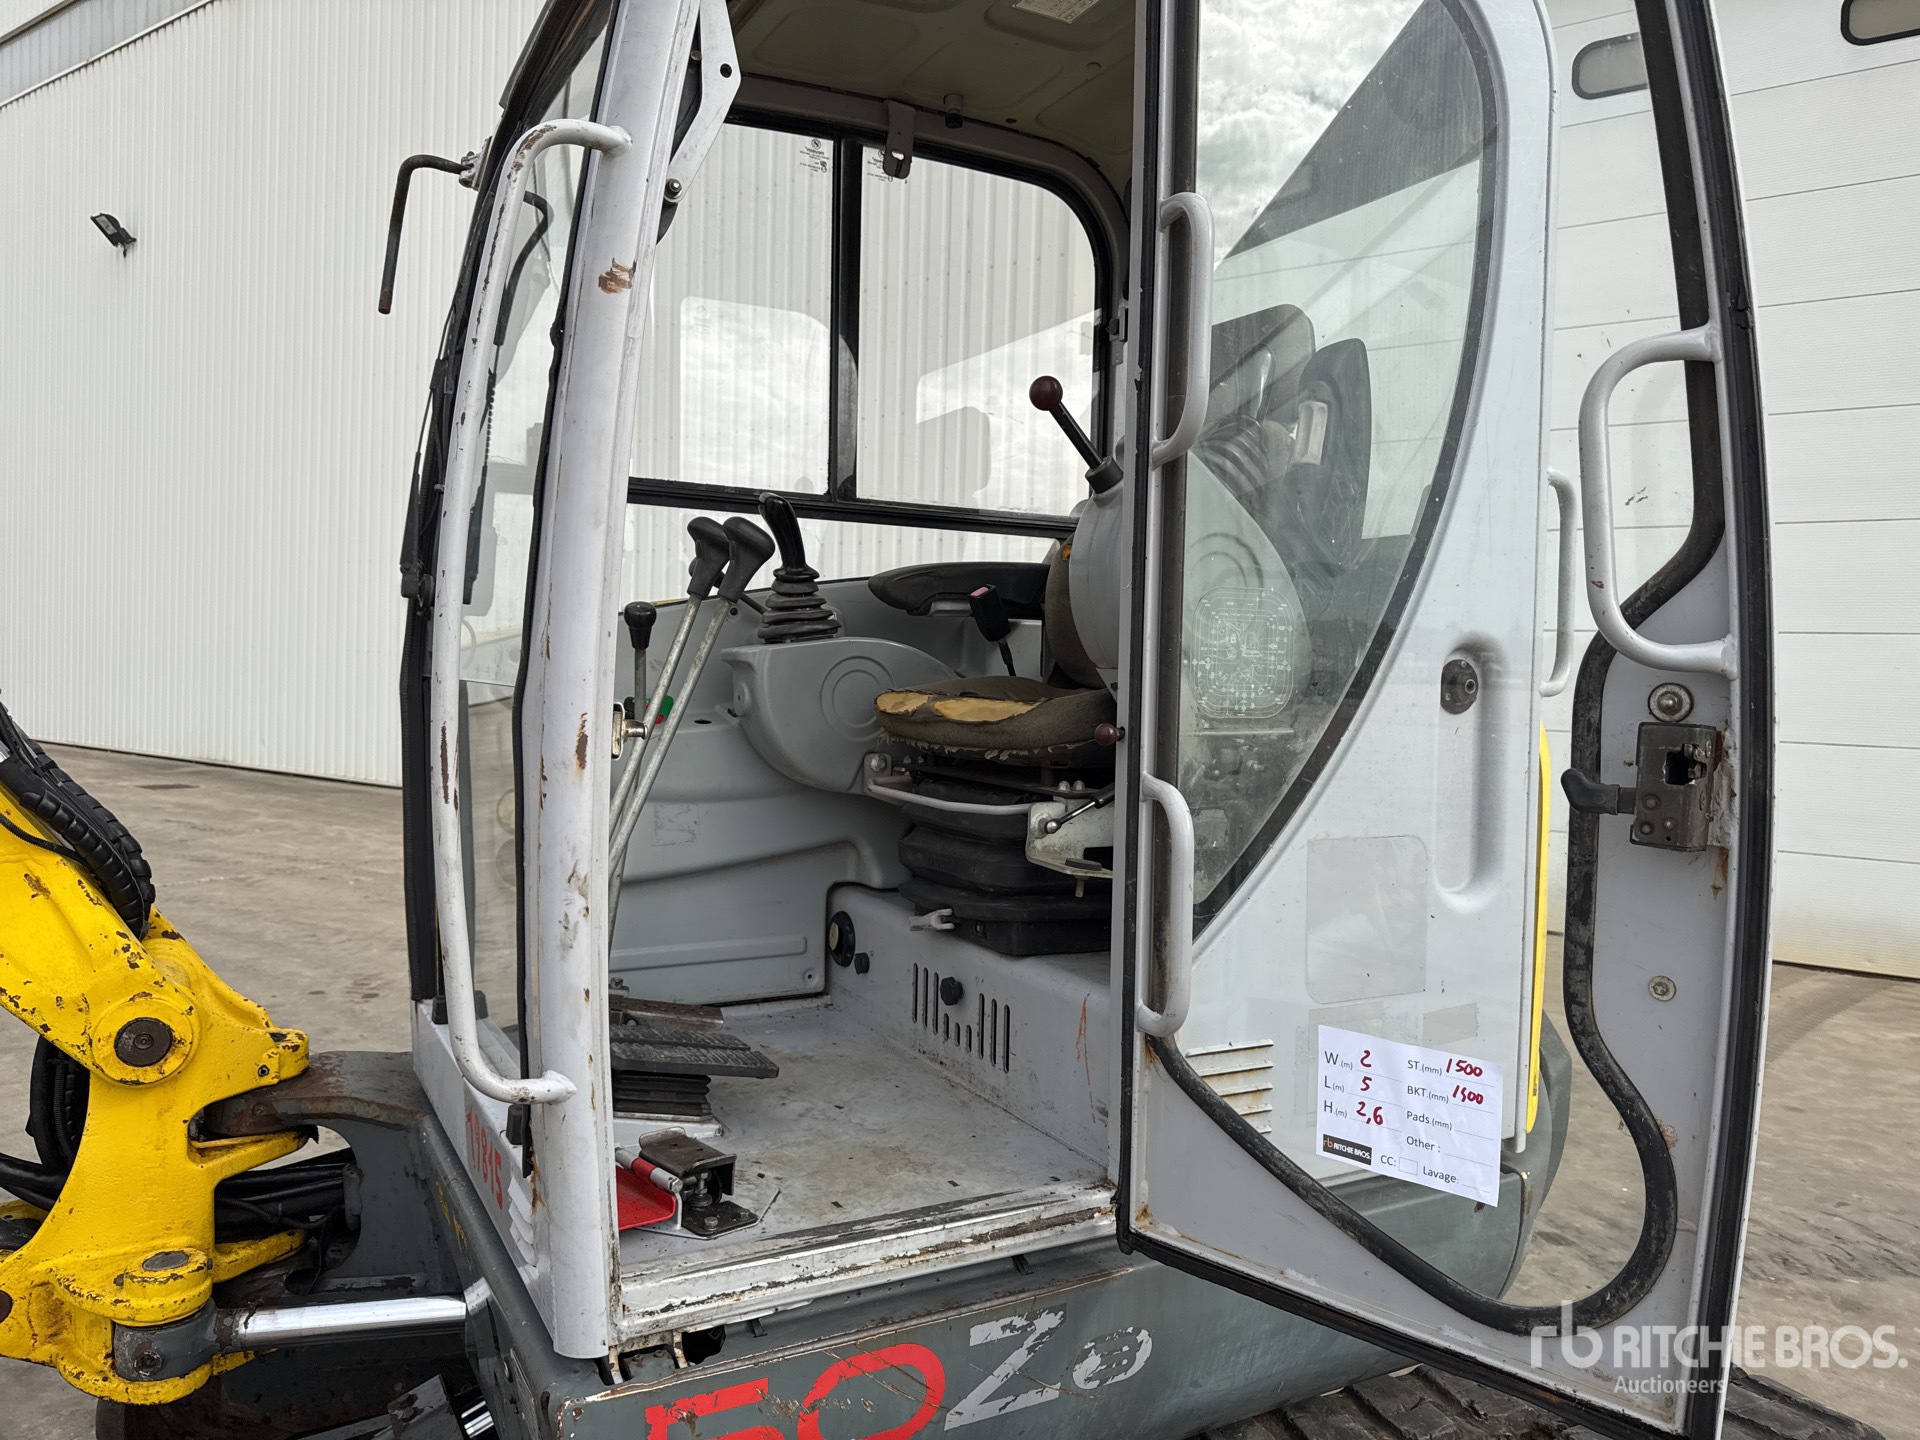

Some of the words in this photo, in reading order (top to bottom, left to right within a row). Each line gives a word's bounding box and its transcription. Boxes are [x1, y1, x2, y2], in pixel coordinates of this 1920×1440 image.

[1360, 1049, 1372, 1068] 2
[1446, 1058, 1483, 1077] 1500
[1360, 1075, 1373, 1091] 5
[1356, 1101, 1384, 1125] 2,6
[1406, 1136, 1436, 1151] Other
[1380, 1154, 1397, 1167] CC:
[1423, 1165, 1460, 1184] Lavage:
